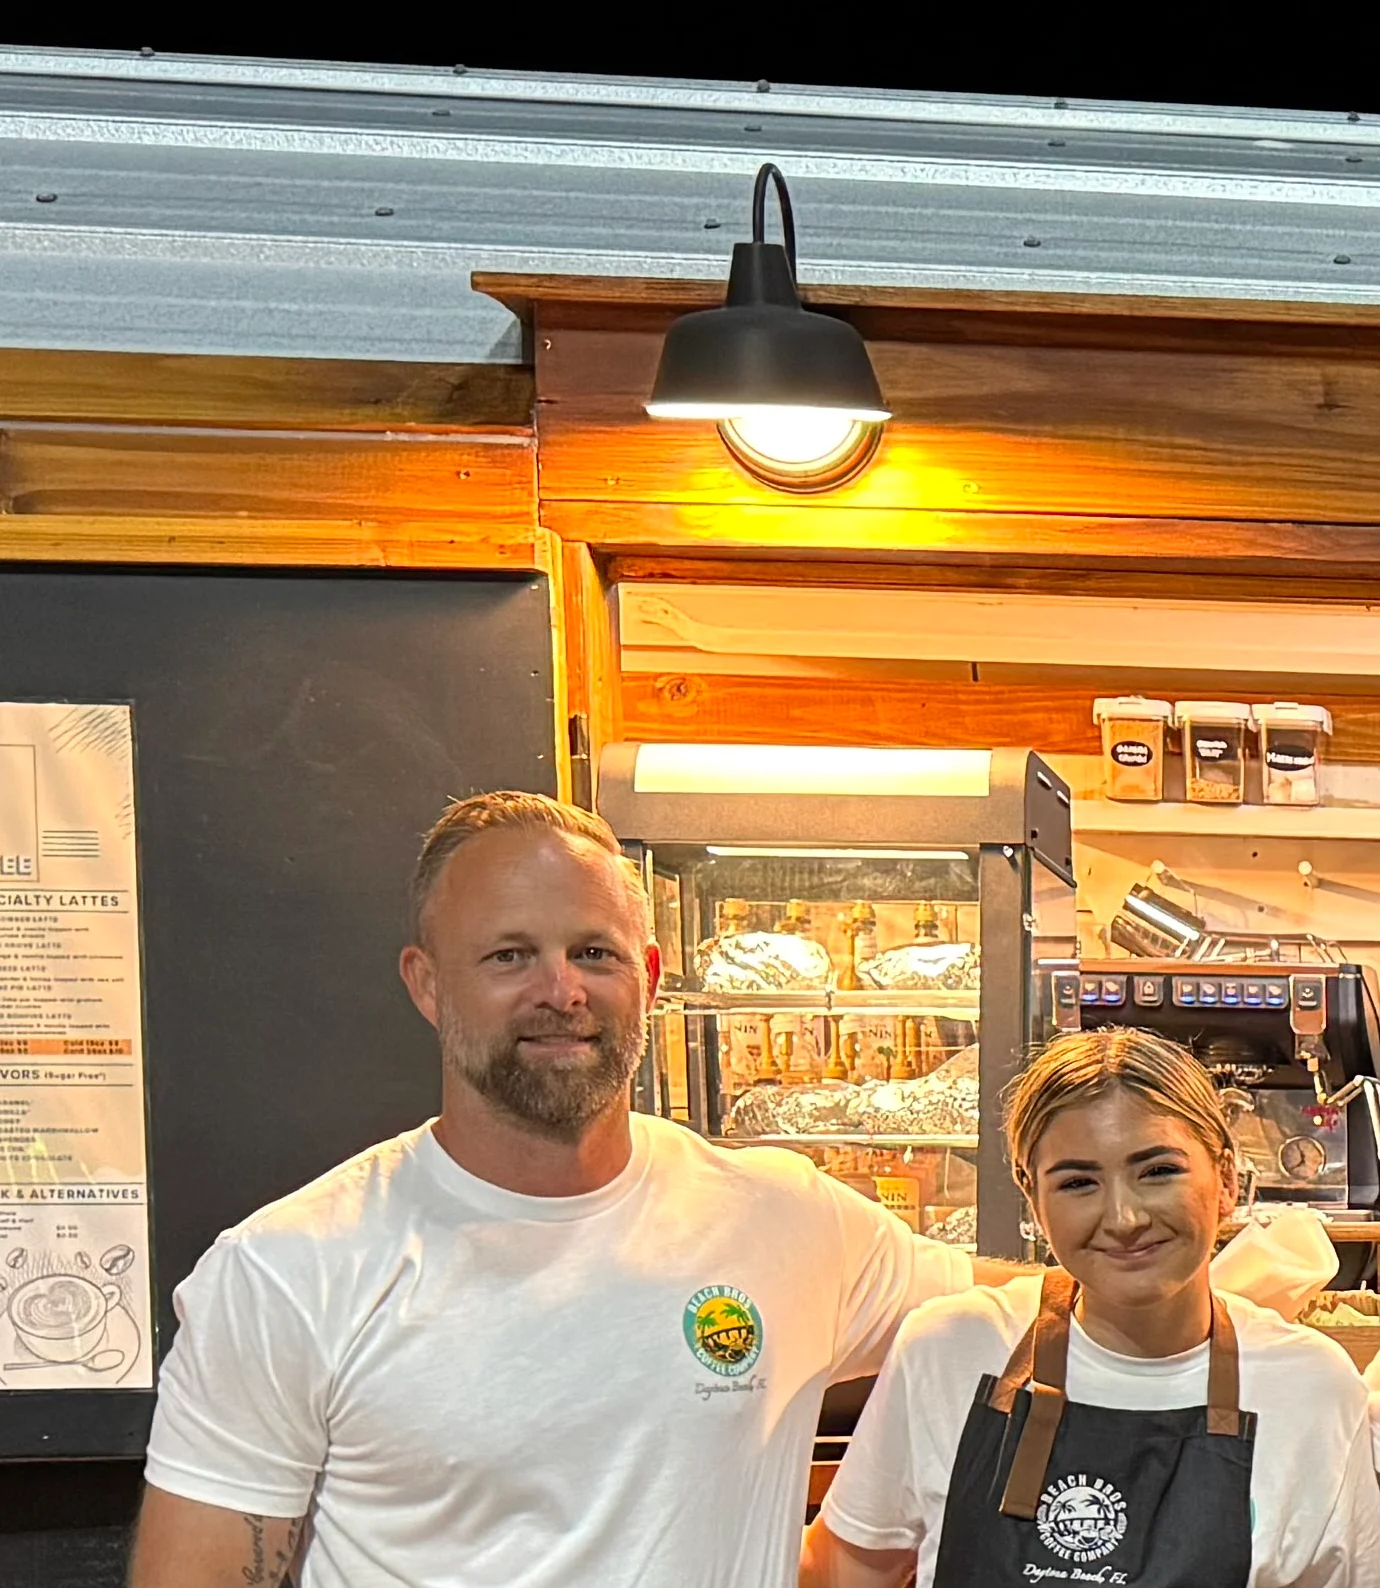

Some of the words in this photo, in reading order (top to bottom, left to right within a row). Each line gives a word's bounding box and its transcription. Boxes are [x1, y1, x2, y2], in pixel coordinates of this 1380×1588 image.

[60, 895, 119, 907] LATTES
[16, 1189, 25, 1199] &
[30, 1189, 139, 1199] ALTERNATIVES
[687, 1286, 720, 1313] BEACH
[723, 1286, 753, 1309] BROS
[1040, 1474, 1087, 1504] BEACH
[1093, 1478, 1127, 1511] BROS
[1040, 1532, 1072, 1560] COFFEE
[1073, 1538, 1119, 1562] COMPANY
